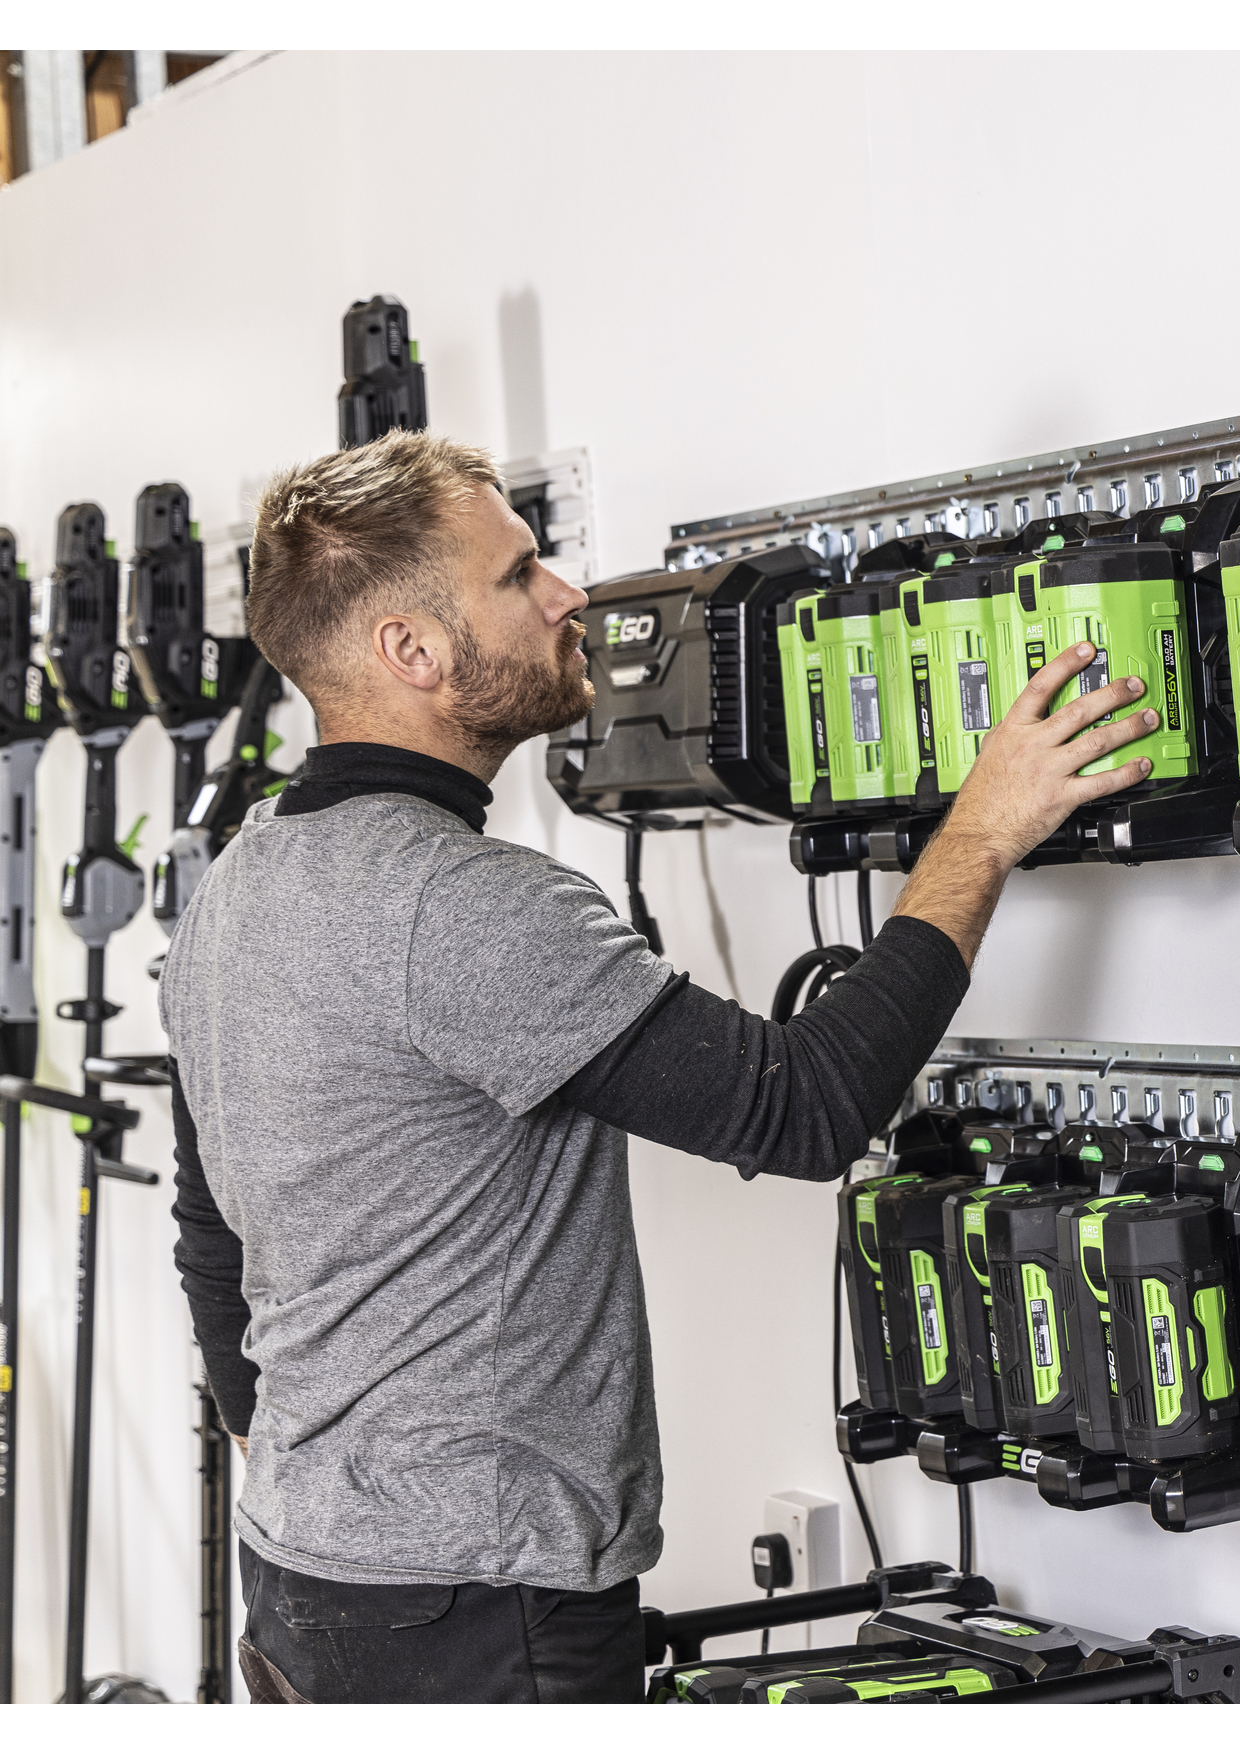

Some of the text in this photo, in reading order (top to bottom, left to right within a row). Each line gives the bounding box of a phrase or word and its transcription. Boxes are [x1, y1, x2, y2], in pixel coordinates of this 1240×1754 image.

[606, 614, 654, 644] EGO
[1026, 625, 1042, 634] ARC
[911, 639, 926, 648] ARC
[1163, 634, 1168, 646] AH
[807, 653, 820, 662] ARC
[202, 638, 219, 700] EGO
[1166, 671, 1177, 702] 56V
[922, 708, 930, 751] EGO
[966, 1213, 980, 1221] ARC
[1082, 1225, 1098, 1234] ARC
[1108, 1350, 1118, 1394] EGO
[1002, 1444, 1042, 1474] EG
